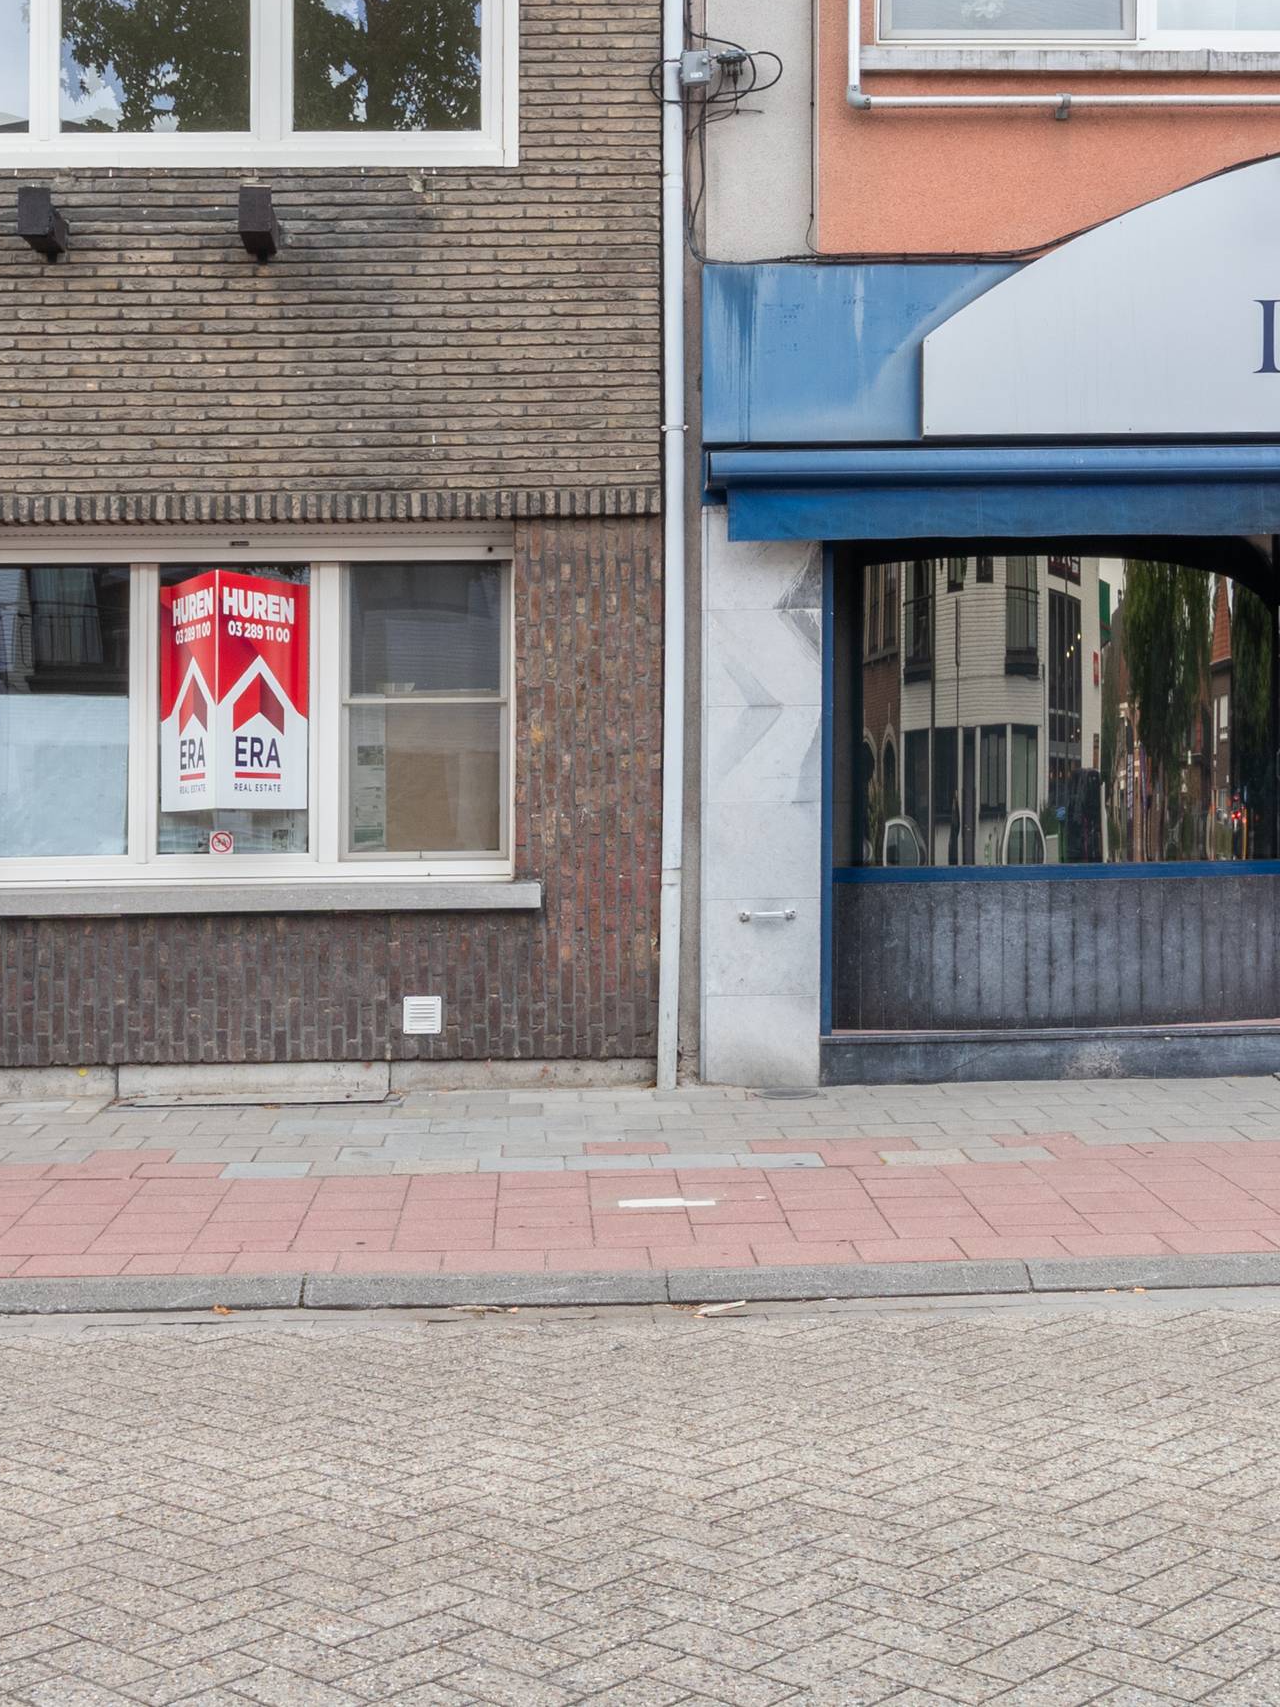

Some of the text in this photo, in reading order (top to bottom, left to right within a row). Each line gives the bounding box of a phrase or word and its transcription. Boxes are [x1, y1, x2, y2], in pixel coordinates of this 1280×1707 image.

[173, 587, 214, 626] HUREN
[223, 586, 295, 625] HUREN
[175, 620, 211, 645] 03 289 11 00
[228, 620, 290, 643] 03 289 11 00
[180, 737, 206, 770] ERA
[235, 736, 281, 768] ERA
[234, 782, 281, 793] REAL ESTATE
